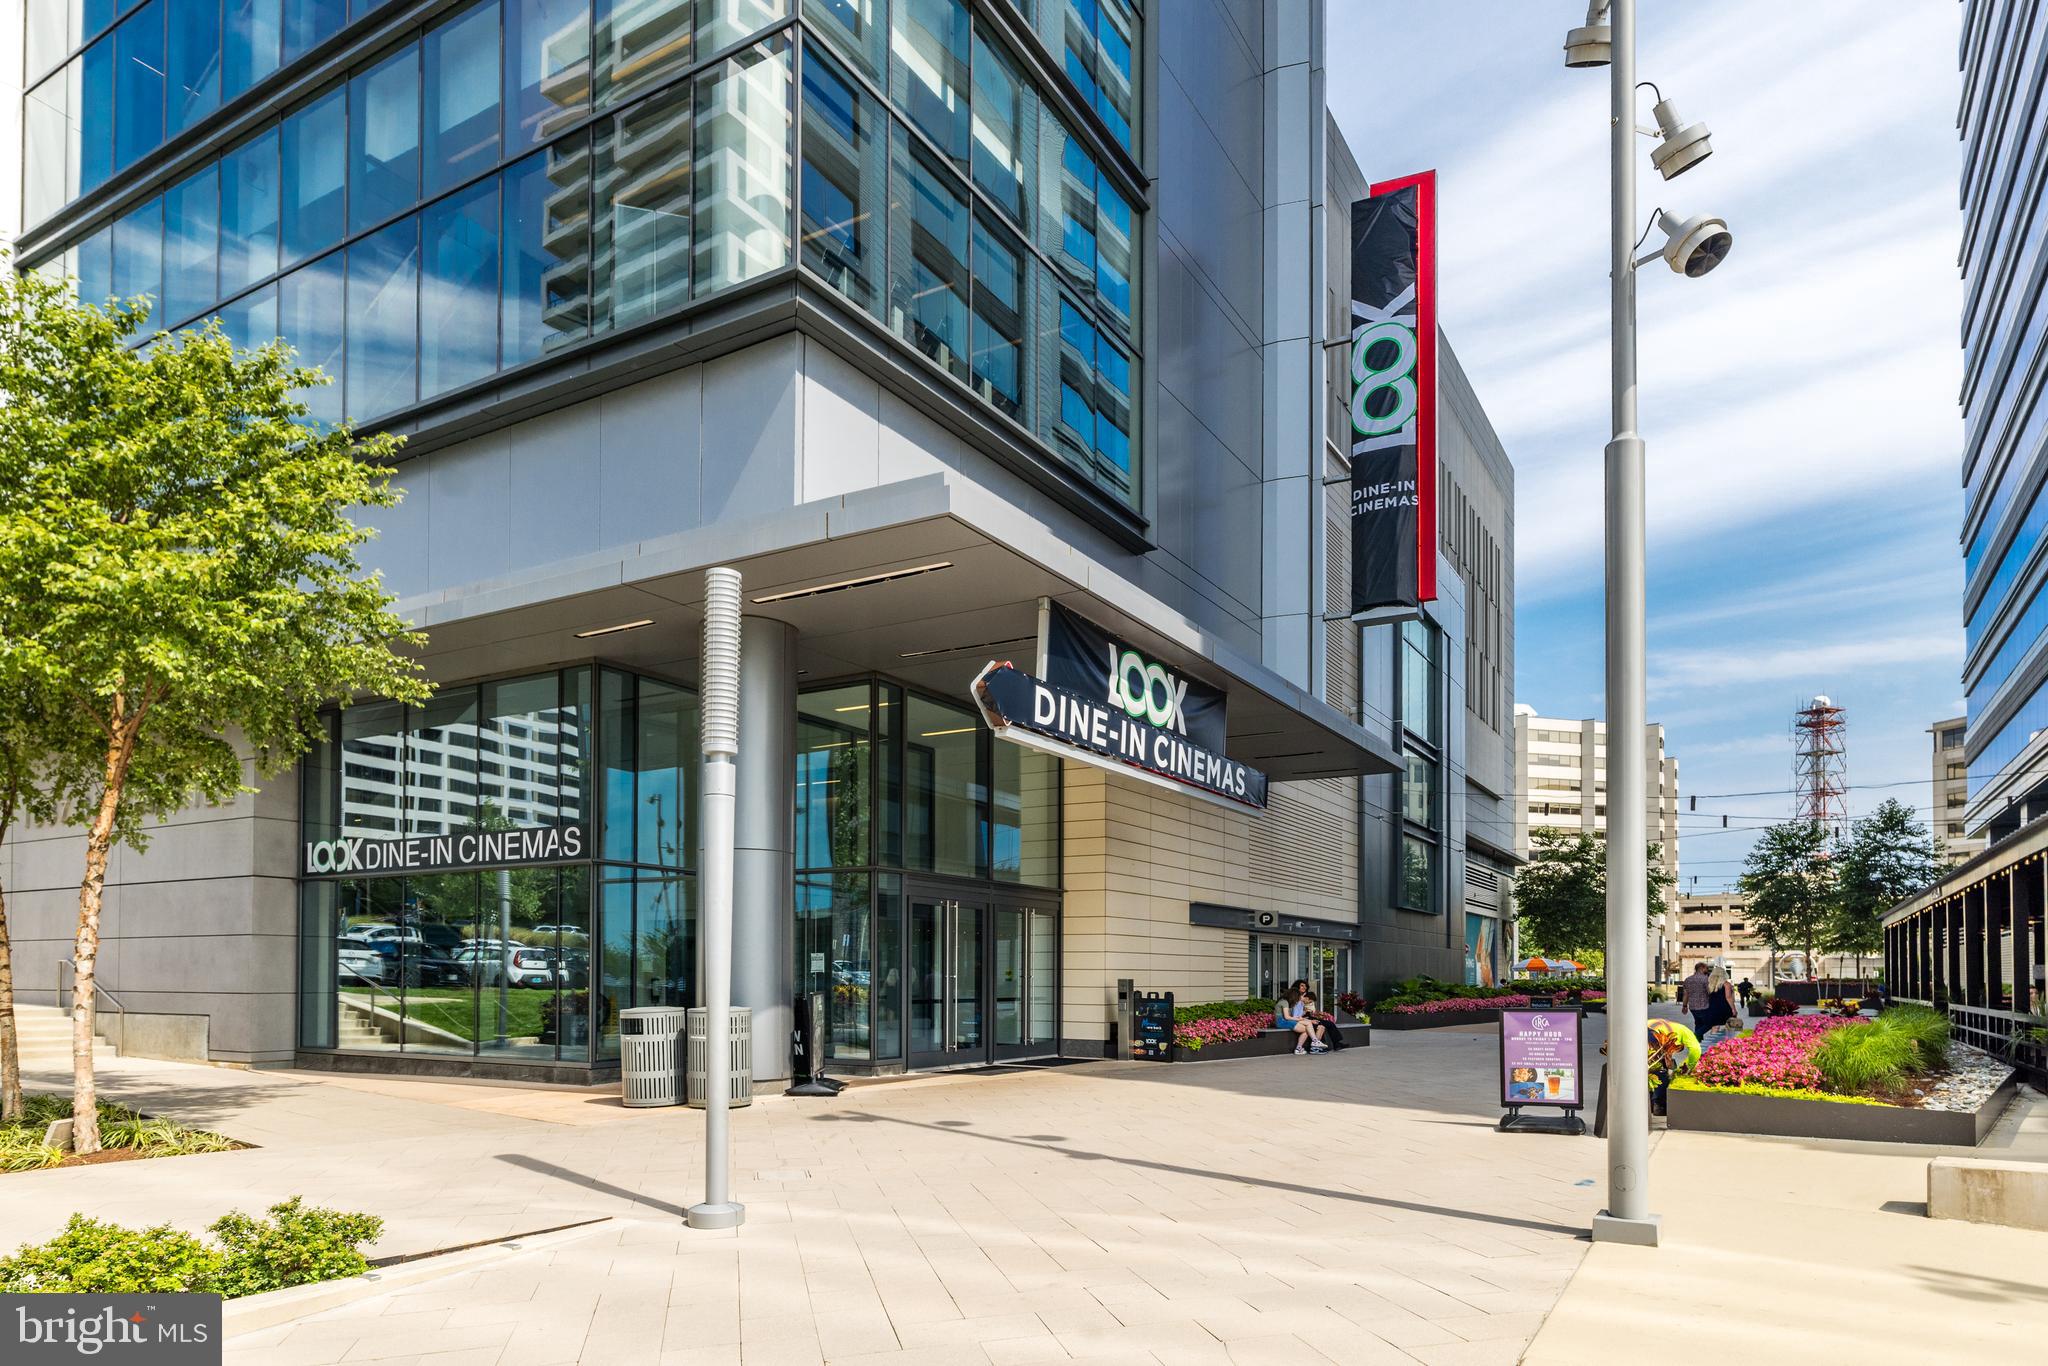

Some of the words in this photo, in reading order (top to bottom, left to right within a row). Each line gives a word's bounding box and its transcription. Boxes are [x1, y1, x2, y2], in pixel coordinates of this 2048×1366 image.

[1351, 495, 1419, 517] CINEMAS
[1353, 480, 1415, 501] DINE-IN
[1108, 642, 1188, 736] LOOK
[1034, 684, 1146, 761] DINE-IN
[1154, 735, 1246, 796] CINEMAS
[307, 838, 363, 873] LOOK
[366, 837, 452, 870] DINE-IN
[459, 826, 581, 864] CINEMAS
